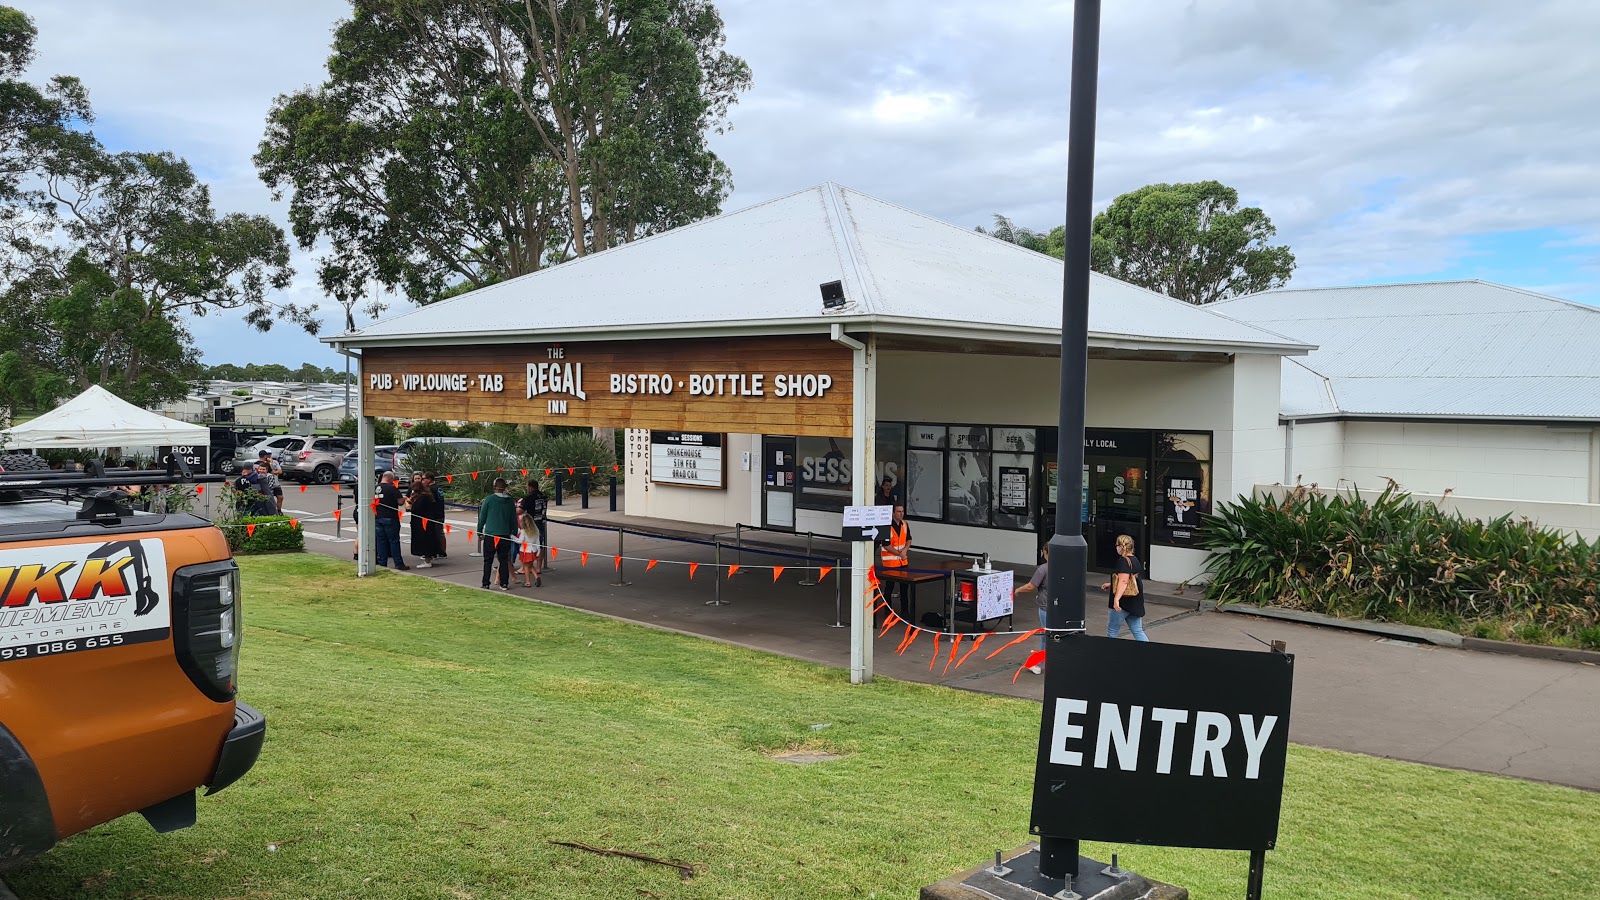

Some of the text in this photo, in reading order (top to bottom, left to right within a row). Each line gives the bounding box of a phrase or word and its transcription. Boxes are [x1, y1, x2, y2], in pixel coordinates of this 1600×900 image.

[547, 348, 564, 359] THE
[370, 373, 393, 390] PUB
[478, 374, 504, 392] TAB
[526, 362, 586, 401] REGAL
[610, 373, 832, 397] BISTRO BOTTLE SHOP
[547, 400, 568, 414] INN
[681, 433, 703, 443] SESSIONS
[957, 434, 981, 442] SPIRITS
[1095, 439, 1118, 449] LOCAL
[171, 446, 194, 455] BOX
[666, 447, 702, 459] SMOKEHOUSE
[673, 458, 697, 469] 5TH FEB
[1113, 476, 1125, 495] S
[0, 599, 128, 627] IPMENT
[76, 621, 122, 633] HIRE
[37, 640, 77, 655] 086
[86, 634, 124, 648] 655
[1049, 697, 1279, 780] ENTRY
